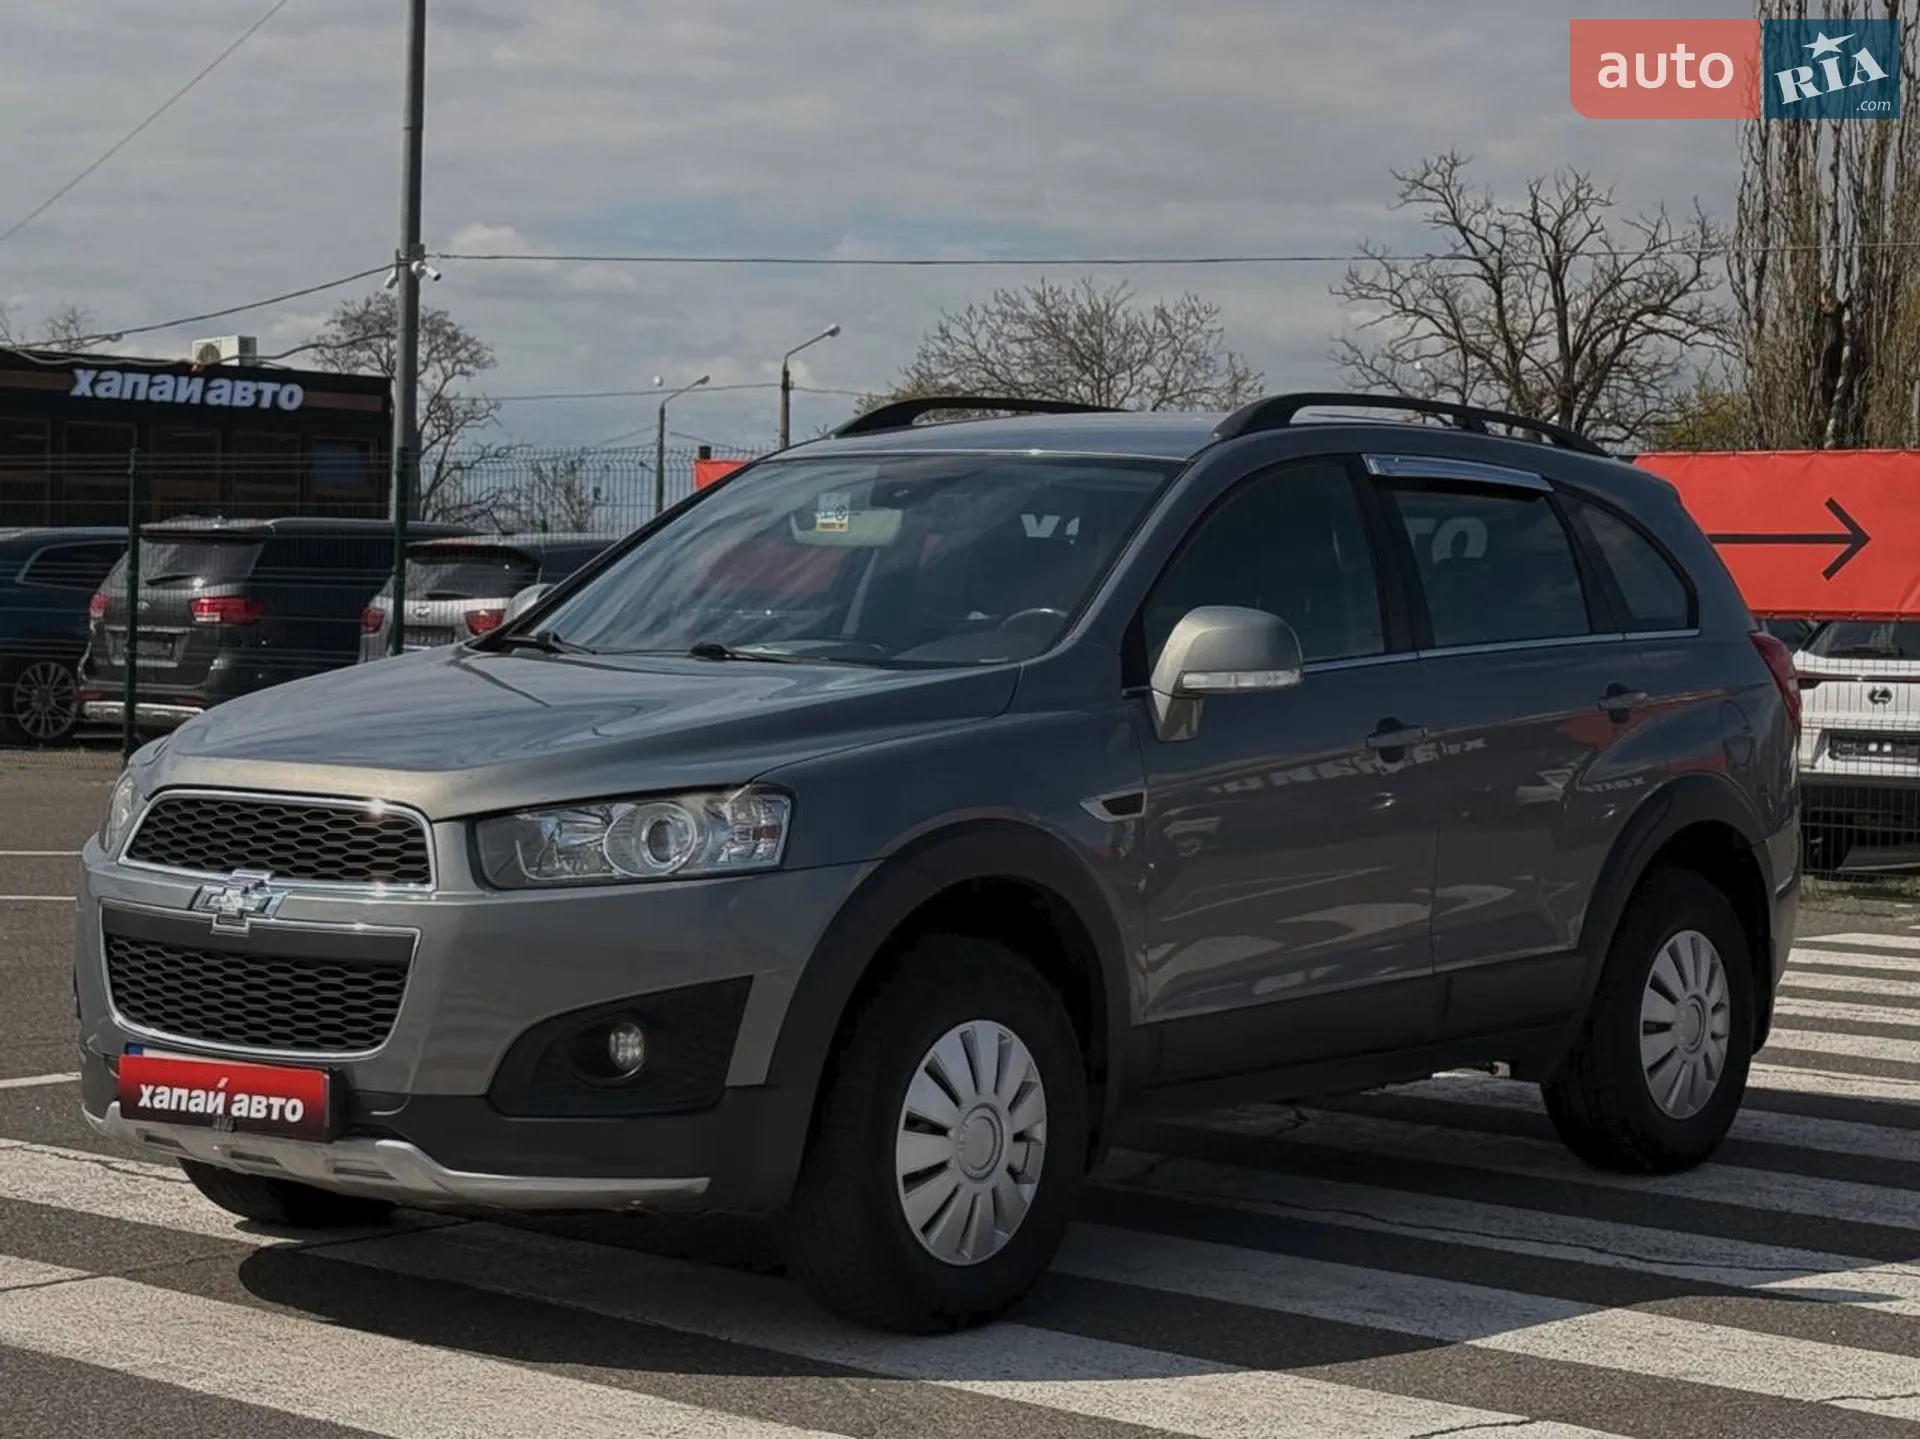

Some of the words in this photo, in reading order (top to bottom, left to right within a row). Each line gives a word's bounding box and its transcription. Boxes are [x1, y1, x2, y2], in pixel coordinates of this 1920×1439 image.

[205, 377, 304, 411] авто
[138, 1077, 229, 1115] хапай
[230, 1093, 304, 1123] авто
